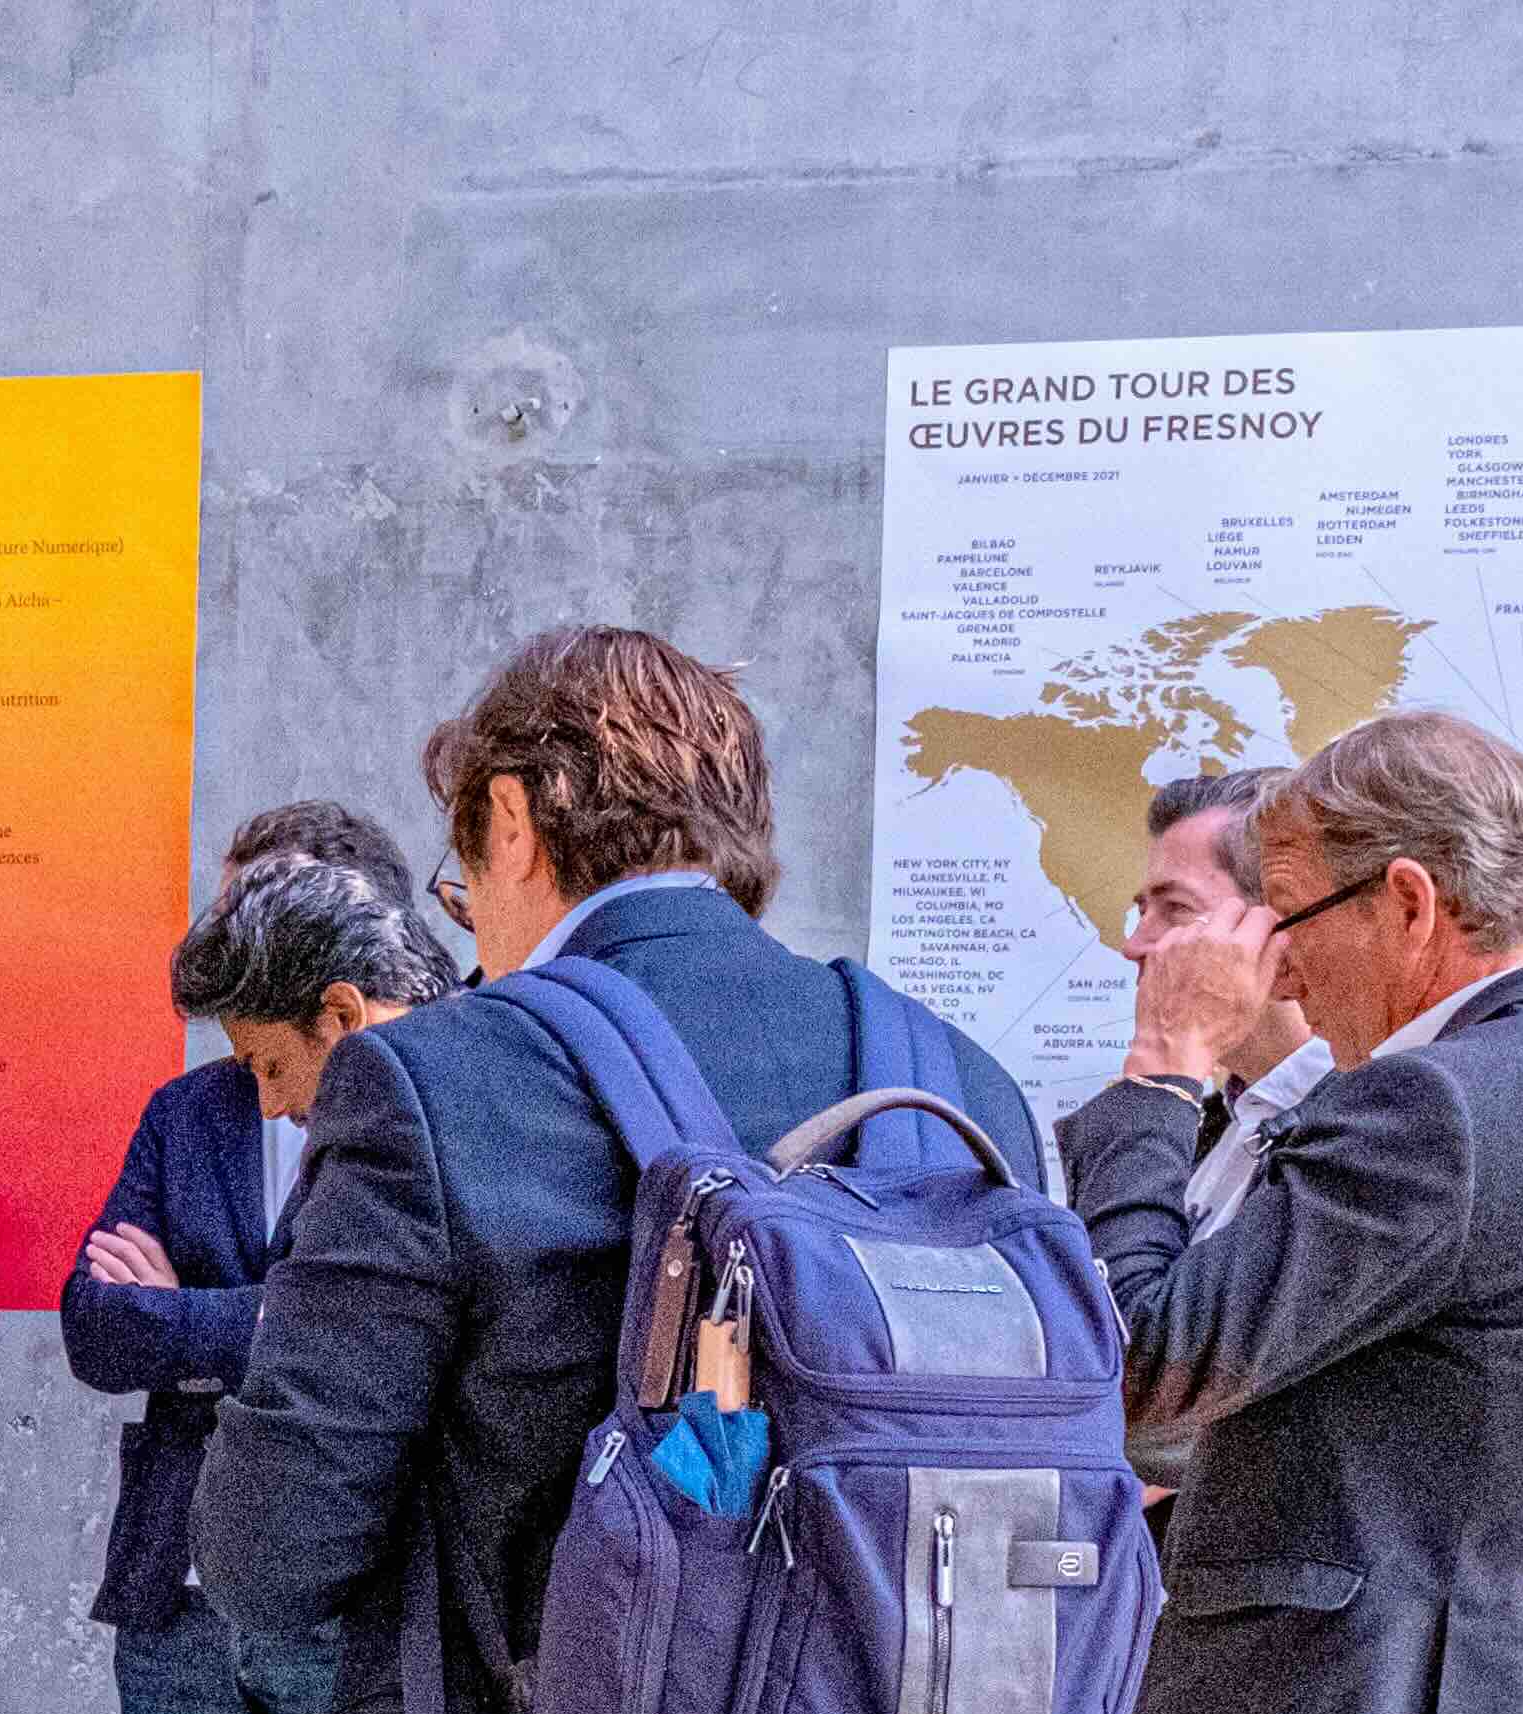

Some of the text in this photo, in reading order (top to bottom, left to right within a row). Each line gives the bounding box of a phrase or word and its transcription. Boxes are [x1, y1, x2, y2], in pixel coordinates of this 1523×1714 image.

[910, 368, 1296, 406] LE GRAND TOUR DES
[909, 411, 1323, 448] ŒUVRES DU FRESNOY
[1447, 435, 1508, 446] LONDRES
[1447, 449, 1482, 459] YORK
[959, 470, 1120, 484] JANVIER DÉCEMBRE 2021
[1319, 491, 1399, 502] AMSTERDAM
[1346, 505, 1412, 516] NIJMEGEN
[1445, 503, 1485, 514] LEEDS
[1221, 518, 1294, 528] BRUXELLES
[1317, 519, 1397, 530] ROTTERDAM
[1207, 529, 1244, 542] LIÈGE
[1317, 535, 1363, 545] LEIDEN
[972, 539, 1016, 549] BILBAO
[1215, 546, 1260, 556] NAMUR
[938, 553, 1008, 564] PAMPELUNE
[1095, 564, 1161, 575] REYKJAVIK
[1207, 560, 1262, 571] LOUVAIN
[960, 568, 1033, 577] BARCELONE
[953, 582, 1007, 592] VALENCE
[963, 596, 1039, 606] VALLADOLID
[901, 607, 1106, 621] SAINT-JACQUES DE COMPOSTELLE
[957, 624, 1015, 633] GRENADE
[973, 638, 1021, 647] MADRID
[952, 653, 1011, 663] PALENCIA
[893, 859, 1010, 870] NEW YORK CITY, NY
[994, 873, 1007, 882] FL
[971, 888, 985, 896] WI
[916, 901, 1004, 911] COLUMBIA, MO
[892, 915, 914, 924] LOS
[980, 915, 996, 924] CA
[892, 929, 970, 938] HUNTINGTON
[1020, 929, 1036, 938] CA
[920, 943, 988, 952] SAVANNAH,
[889, 957, 947, 967] CHICAGO,
[988, 971, 1004, 980] DC
[1068, 977, 1126, 989] SAN JOSÉ
[905, 984, 995, 994] LAS VEGAS, NV
[1034, 1025, 1084, 1034] BOGOTA
